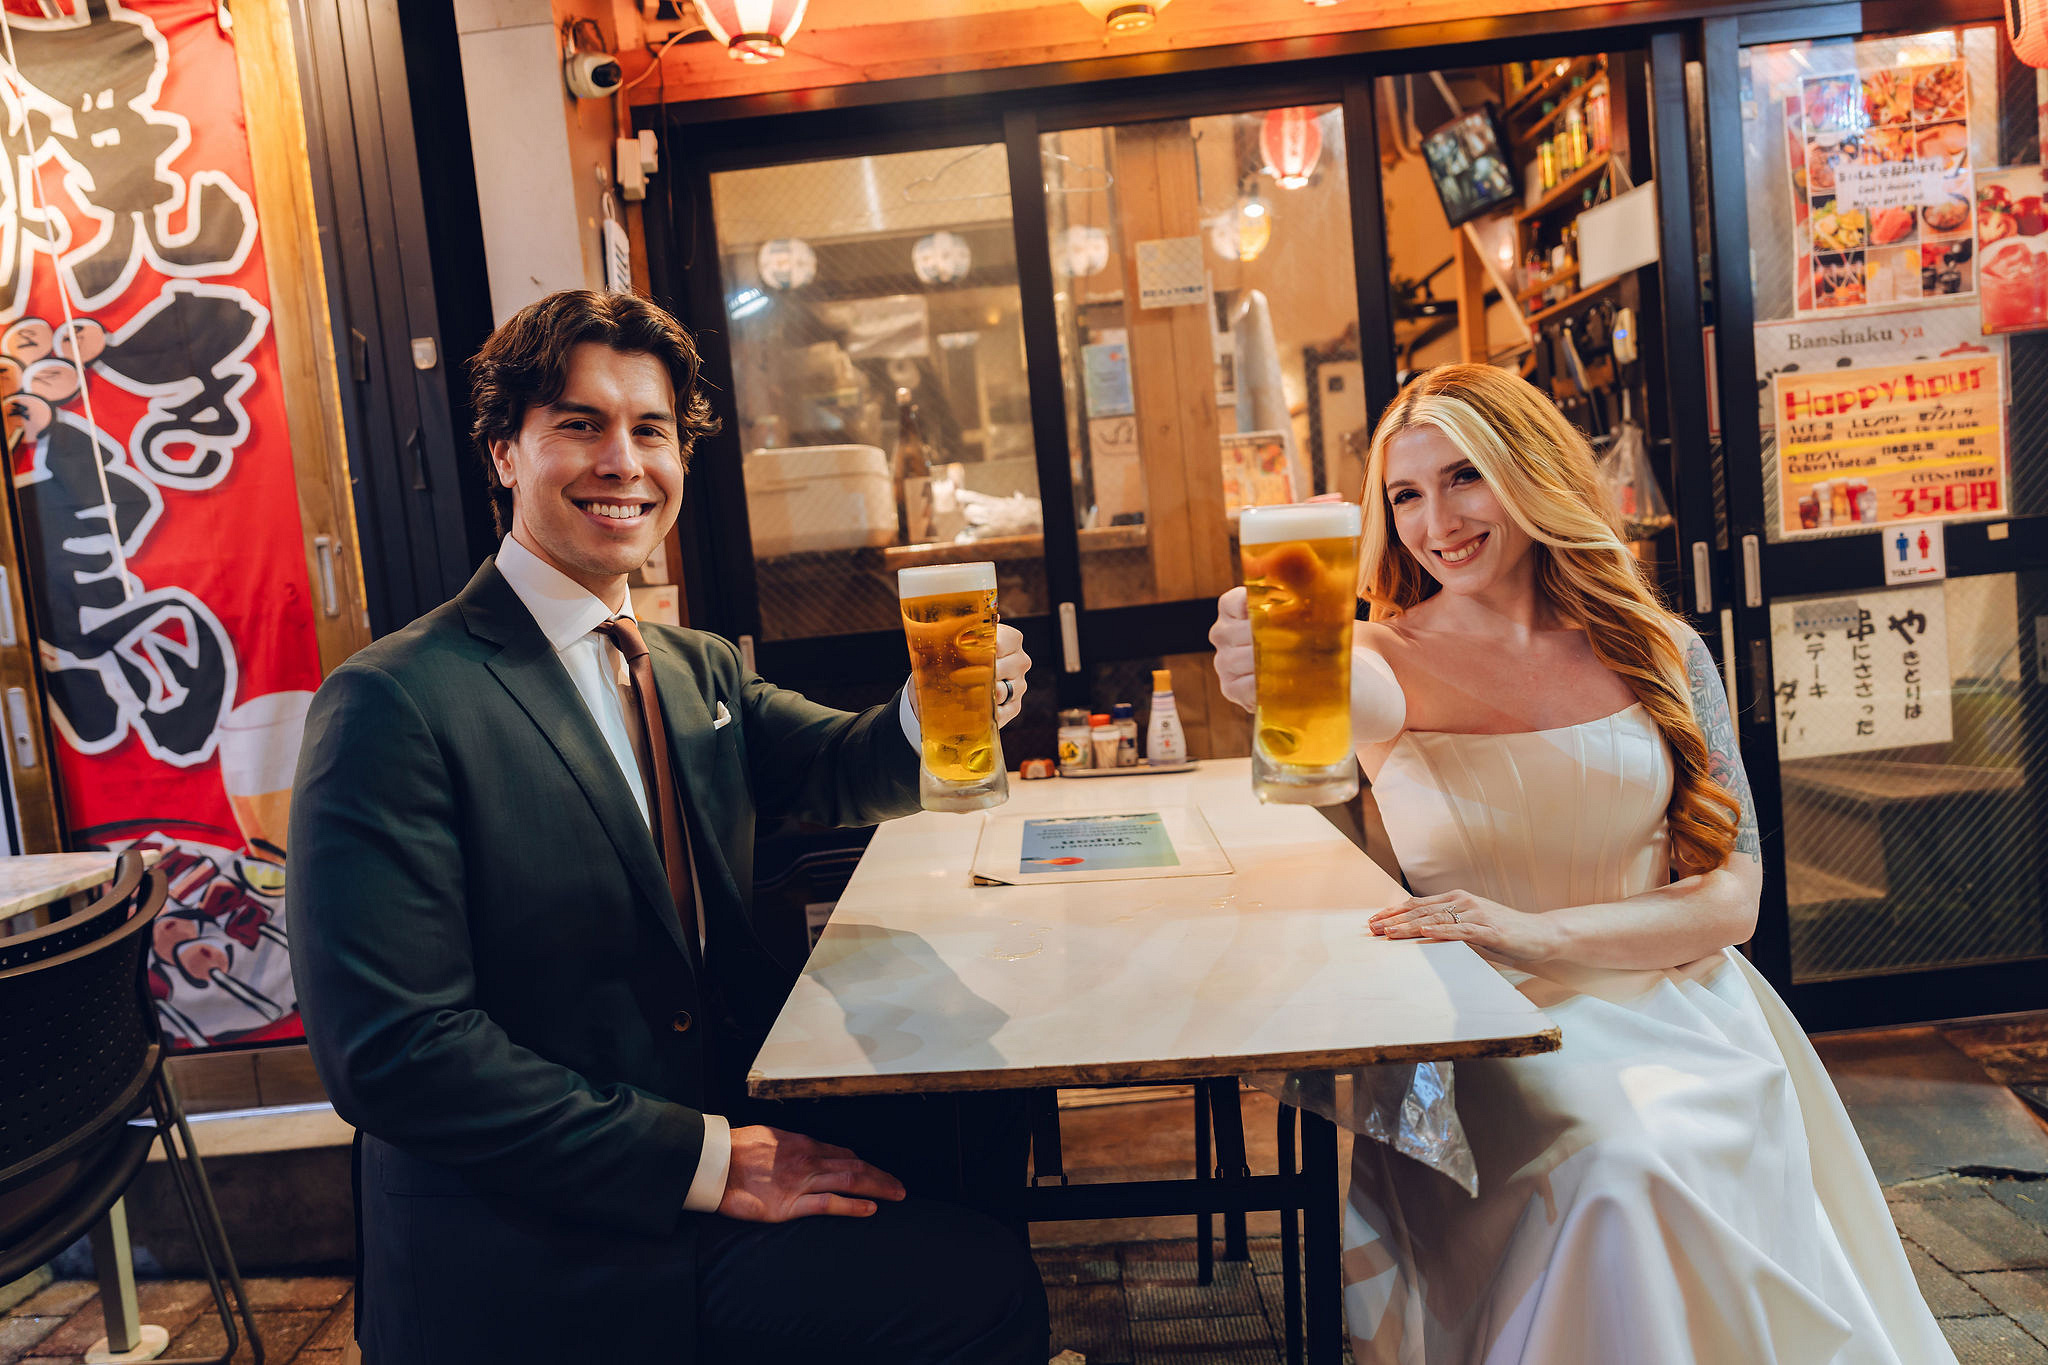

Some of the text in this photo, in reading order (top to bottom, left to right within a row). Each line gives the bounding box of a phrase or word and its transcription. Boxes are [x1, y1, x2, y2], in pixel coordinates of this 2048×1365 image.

[1788, 325, 1924, 351] Banshaku ya
[1785, 366, 1985, 421] Happy hour
[1892, 480, 1998, 518] 350円
[1846, 608, 1876, 736] 串にささった
[1887, 609, 1927, 721] やきとりは
[1062, 837, 1130, 845] Japan
